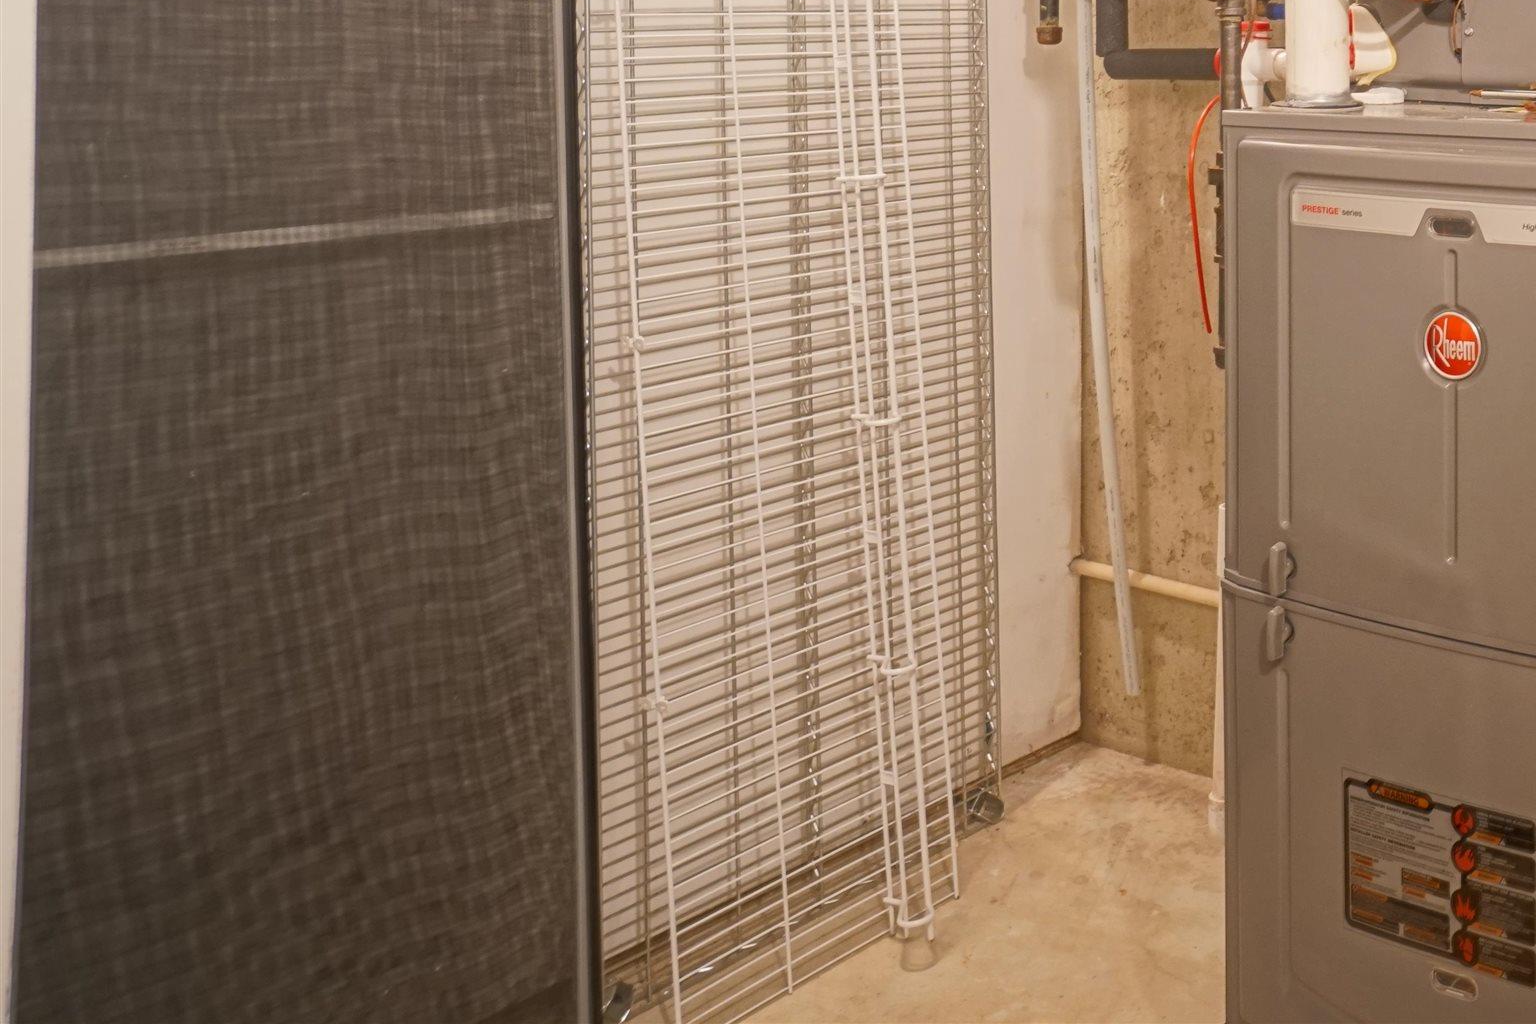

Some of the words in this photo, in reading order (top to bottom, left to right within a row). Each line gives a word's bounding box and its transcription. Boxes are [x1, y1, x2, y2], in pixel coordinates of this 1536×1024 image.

[1302, 204, 1339, 215] PRESTIGE
[1342, 209, 1363, 217] series
[1432, 317, 1476, 367] Rheem
